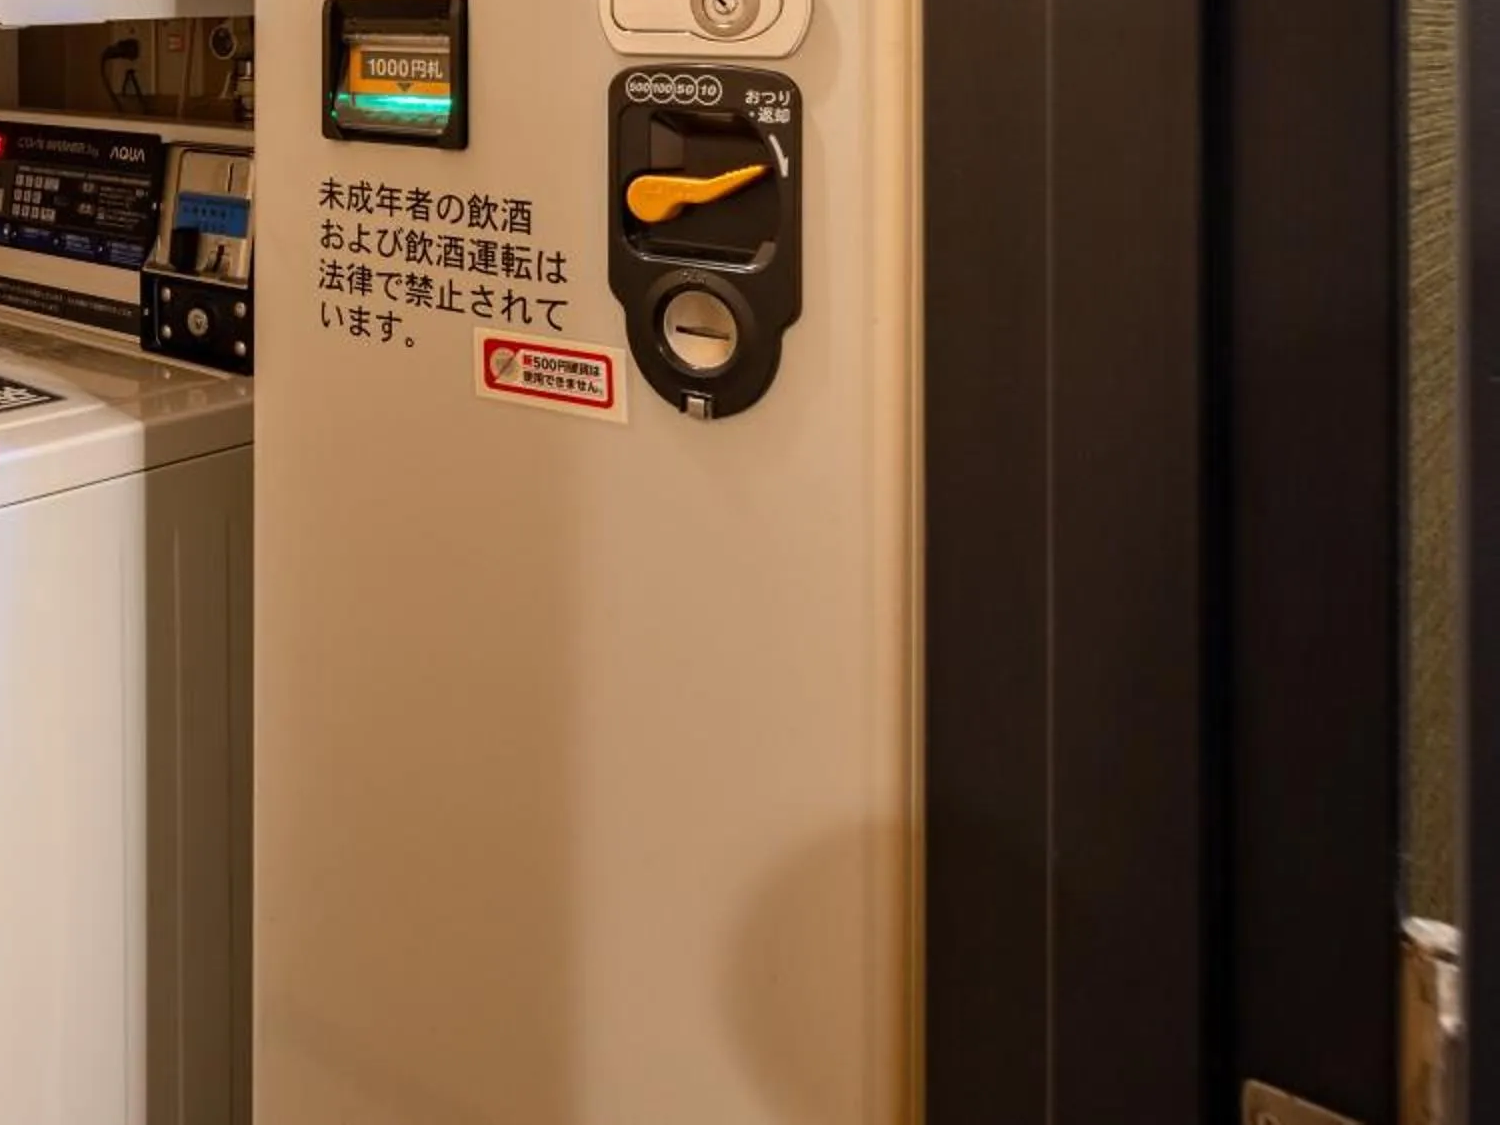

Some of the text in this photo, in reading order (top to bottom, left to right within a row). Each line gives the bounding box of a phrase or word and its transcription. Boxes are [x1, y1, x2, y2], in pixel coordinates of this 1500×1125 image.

[368, 58, 444, 80] 1000円札
[677, 83, 695, 95] 50
[701, 84, 717, 96] 10
[745, 90, 790, 106] おつり
[318, 177, 532, 236] 未成年者の飲酒
[320, 220, 568, 285] および飲酒運転は
[318, 258, 568, 332] 法律で禁止されて
[321, 303, 415, 349] います。
